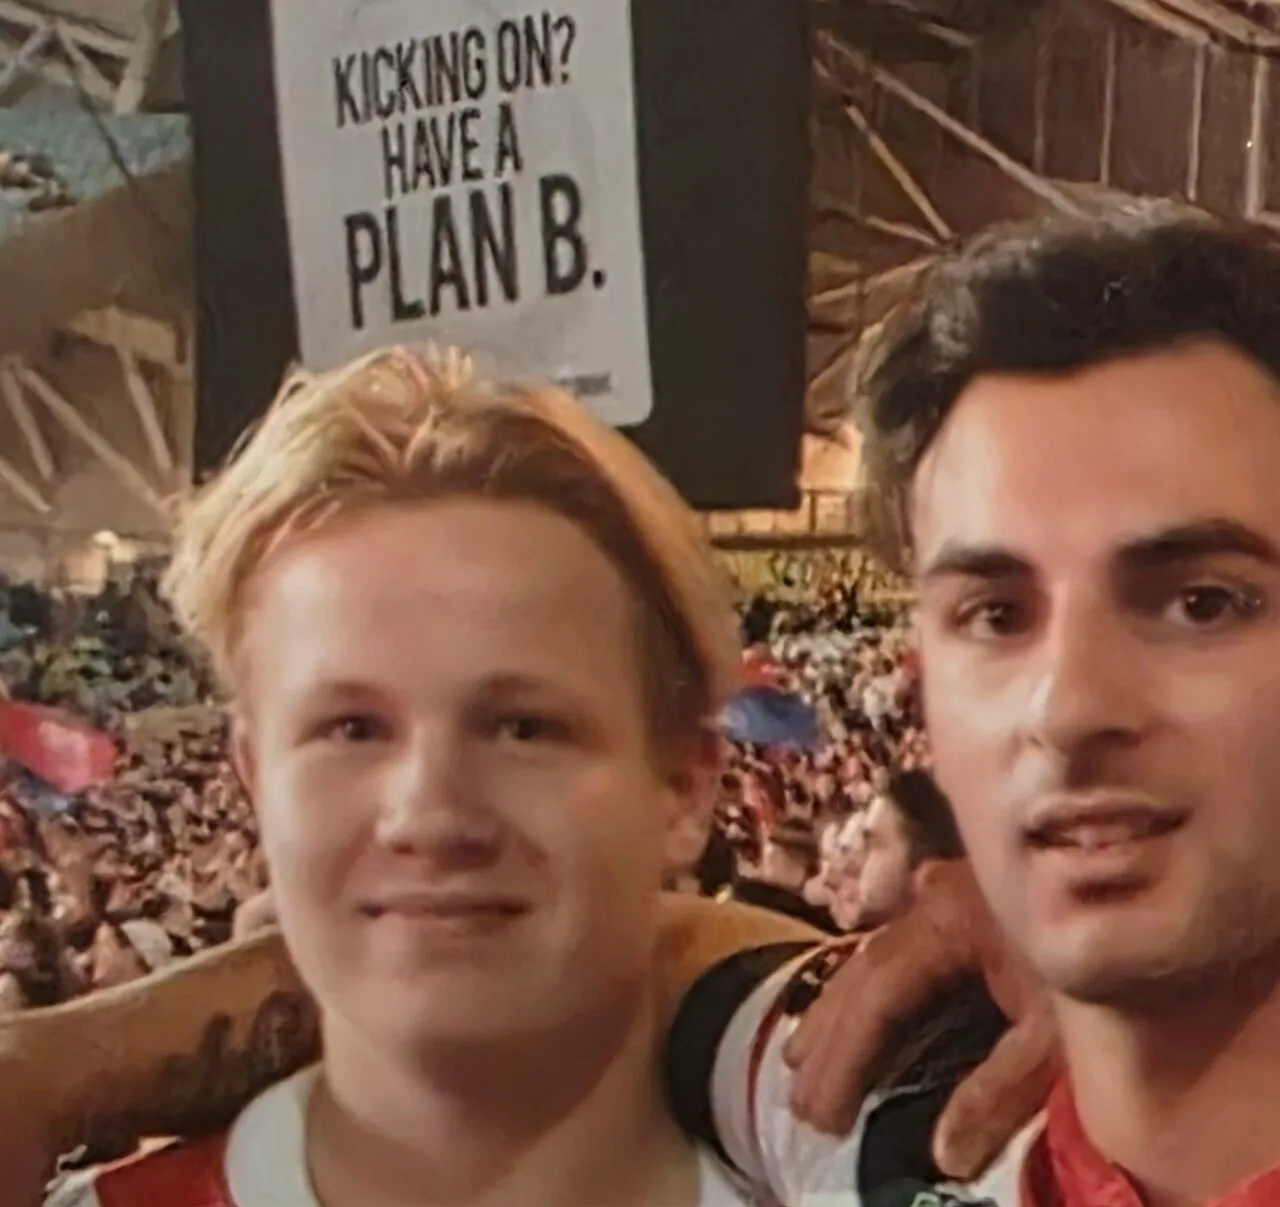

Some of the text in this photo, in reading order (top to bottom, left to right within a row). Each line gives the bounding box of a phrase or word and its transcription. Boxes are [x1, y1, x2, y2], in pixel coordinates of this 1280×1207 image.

[332, 10, 576, 128] KICKING ON?
[382, 102, 523, 197] HAVE A
[344, 174, 606, 330] PLAN B.
